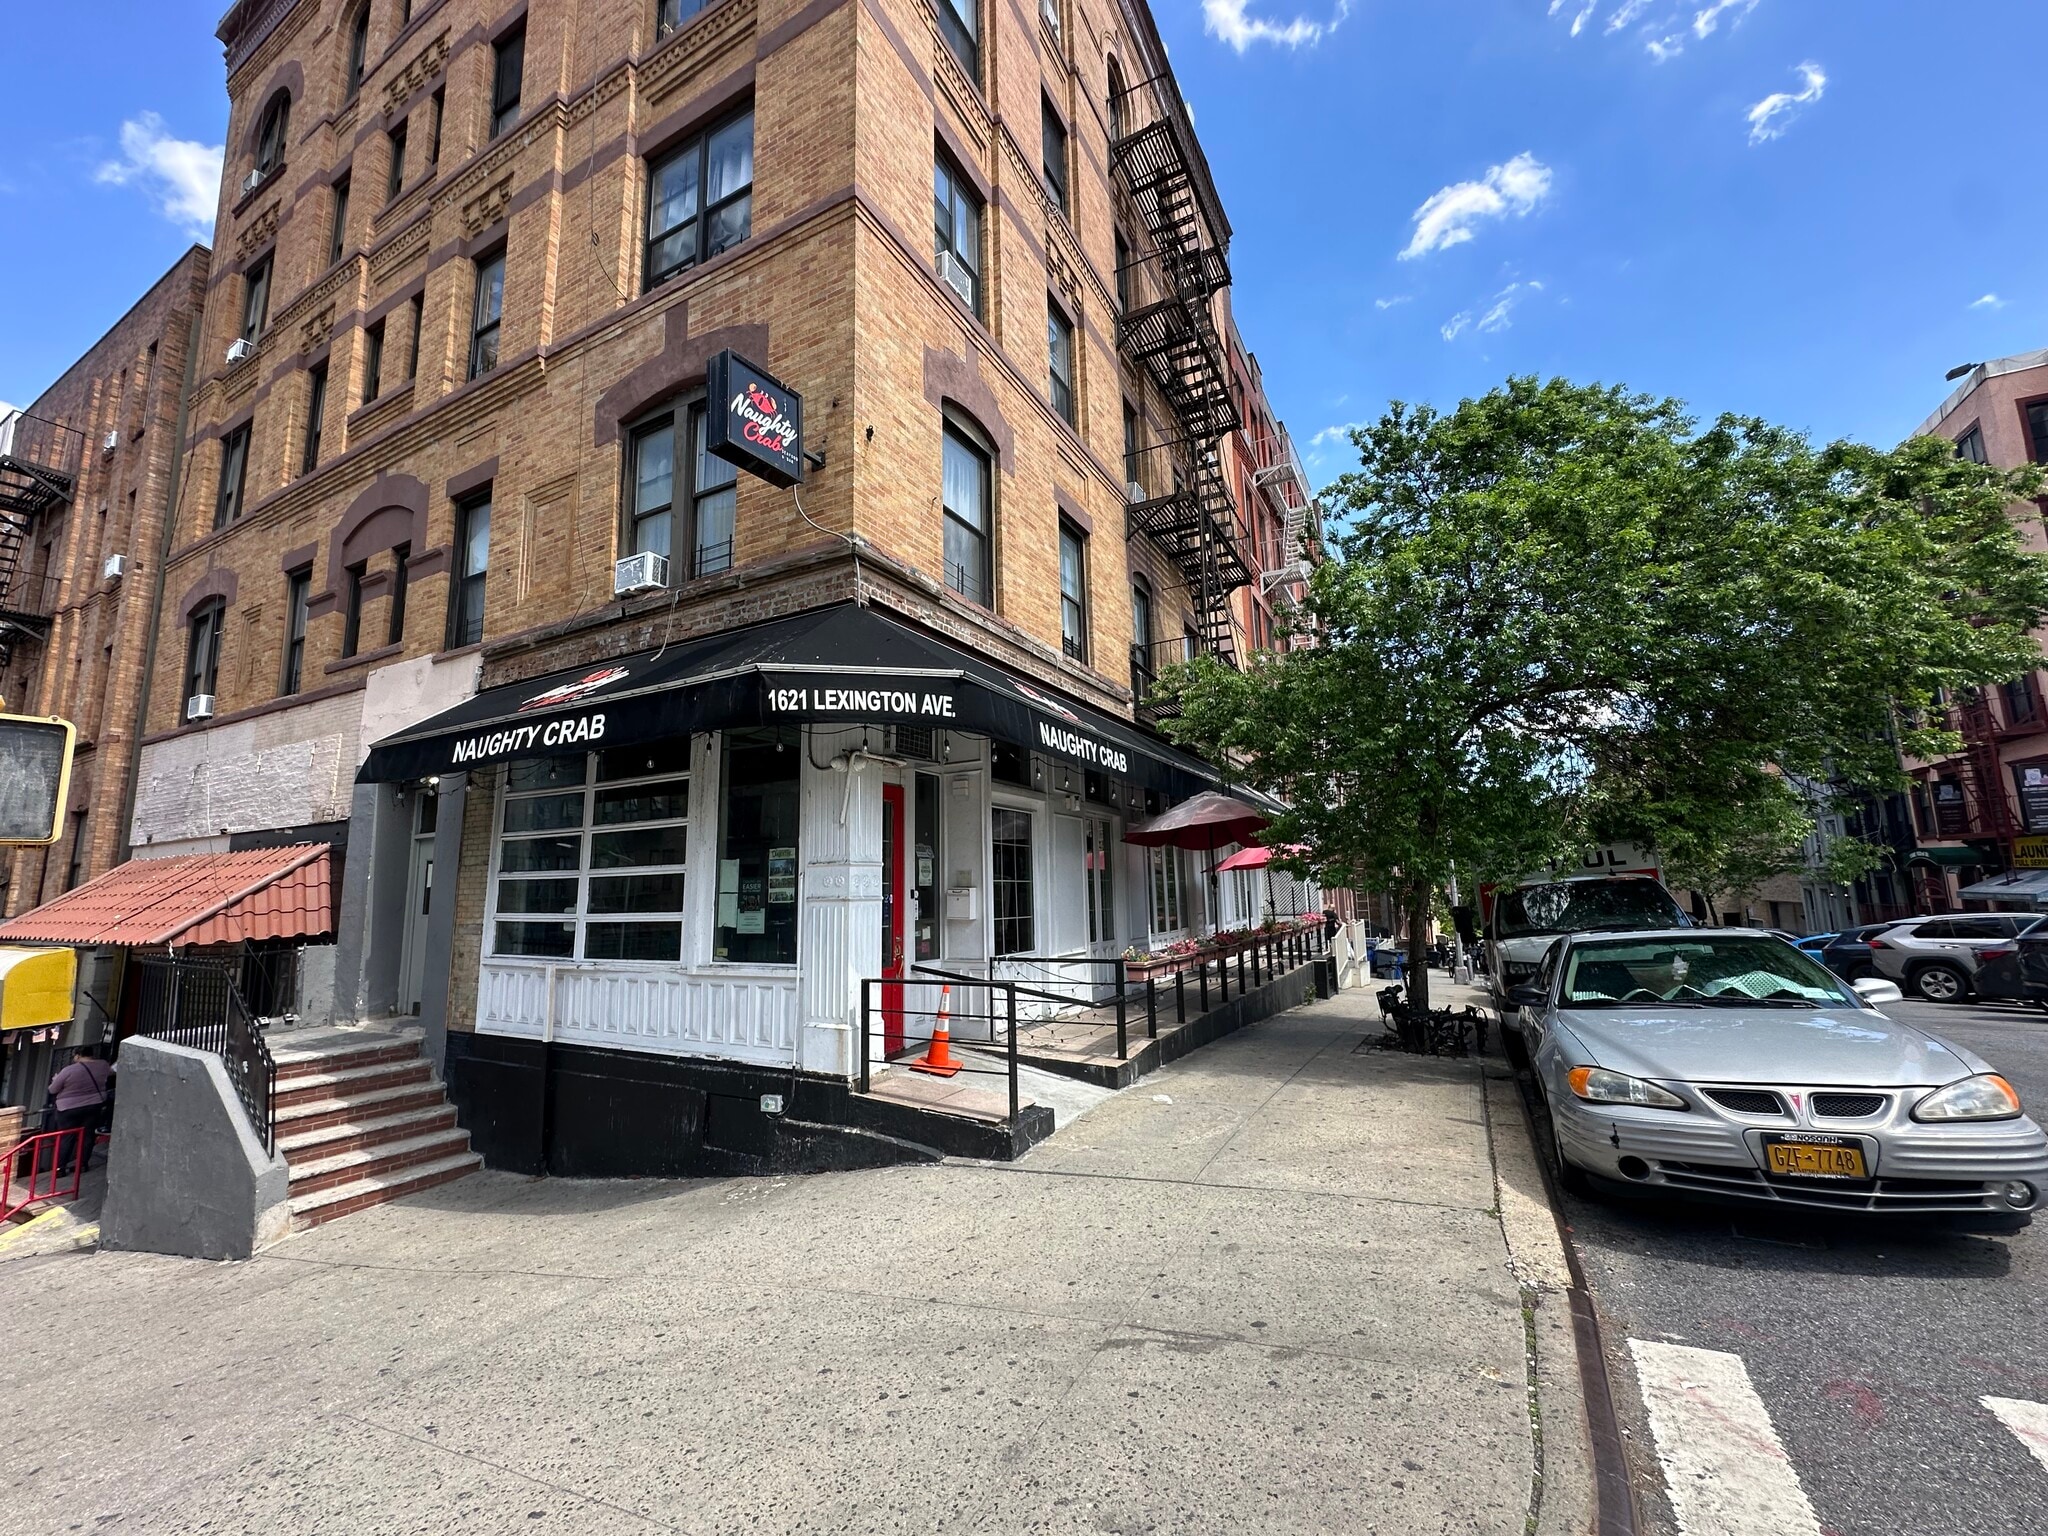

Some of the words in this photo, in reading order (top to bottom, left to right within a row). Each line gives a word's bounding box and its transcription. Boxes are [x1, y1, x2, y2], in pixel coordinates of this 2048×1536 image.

[731, 393, 797, 447] Naughty
[743, 421, 782, 451] Crab
[768, 688, 807, 711] 1621
[814, 689, 916, 714] LEXINGTON
[921, 694, 956, 718] AVE.
[452, 724, 542, 763] NAUGHTY
[543, 714, 606, 746] CRAB
[1039, 721, 1097, 762] NAUGHTY
[1099, 745, 1127, 773] CRAB
[1797, 1134, 1837, 1143] HUDSON
